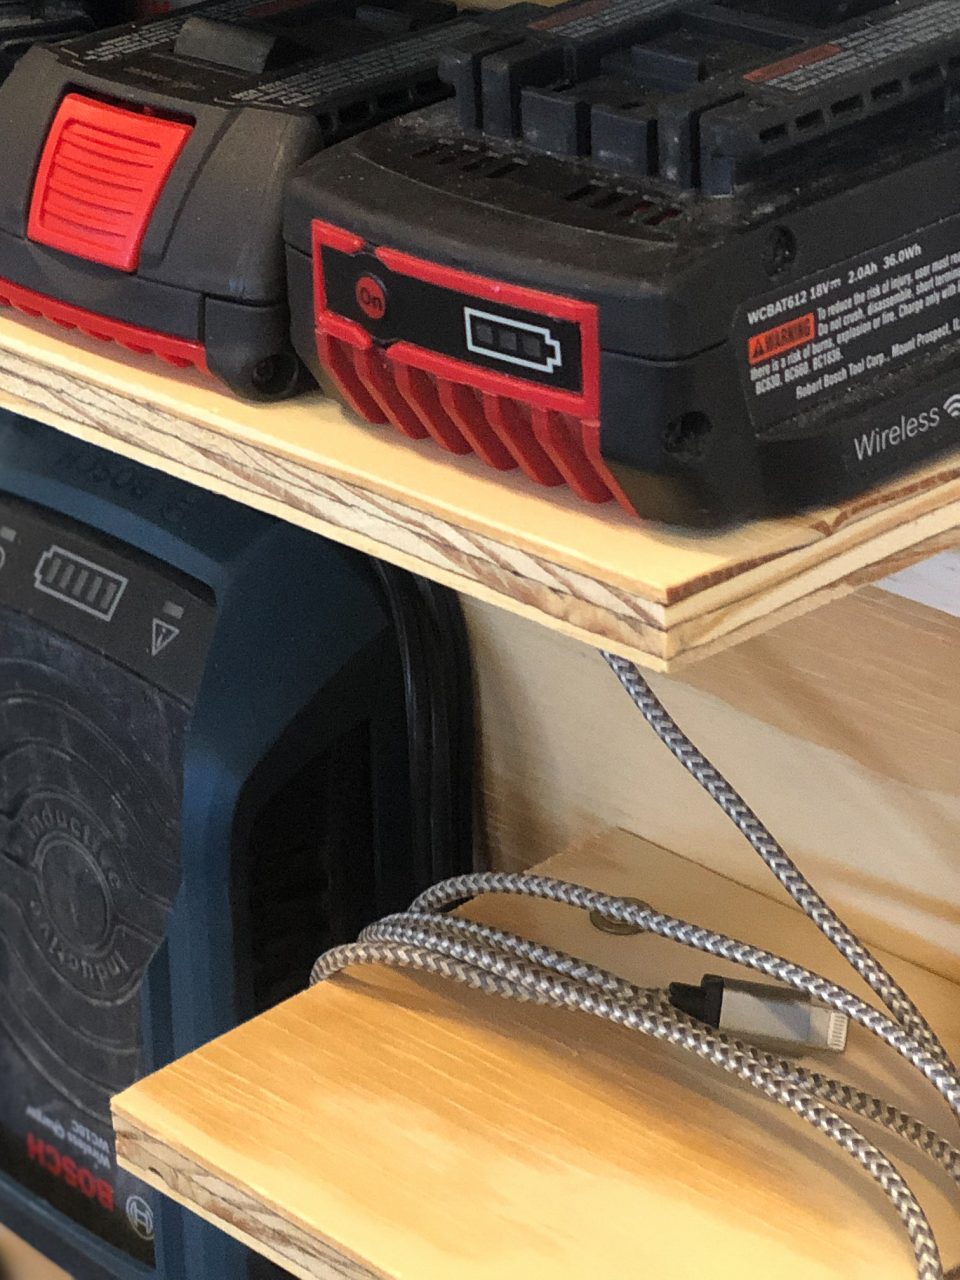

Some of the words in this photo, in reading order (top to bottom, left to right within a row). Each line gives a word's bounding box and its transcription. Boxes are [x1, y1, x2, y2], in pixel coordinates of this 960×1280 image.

[360, 287, 383, 312] On
[747, 290, 808, 325] WCBAT612
[847, 262, 878, 284] 2.0Ah
[882, 243, 922, 270] 36.0Wh
[853, 406, 940, 461] Wireless
[27, 1131, 114, 1212] BOSCH
